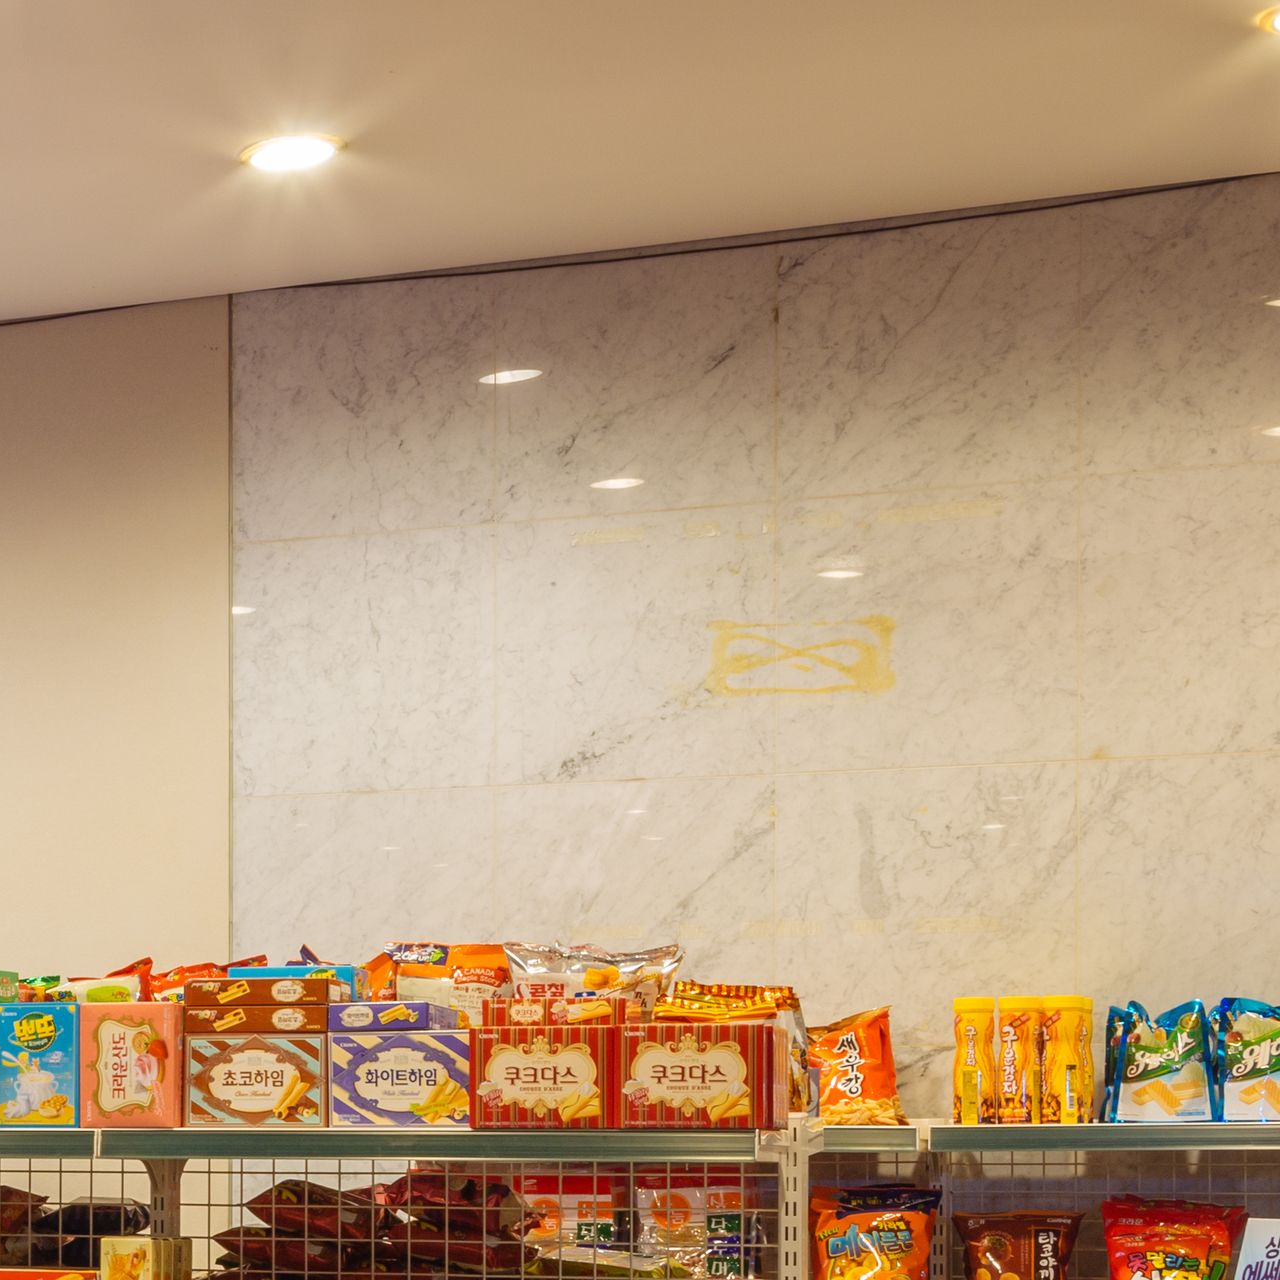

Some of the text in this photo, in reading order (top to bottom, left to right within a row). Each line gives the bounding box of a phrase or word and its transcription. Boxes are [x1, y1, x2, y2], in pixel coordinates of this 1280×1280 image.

[464, 968, 495, 977] CANADA
[836, 1034, 864, 1097] 새우깡
[1001, 1026, 1018, 1094] 구운감자
[221, 1069, 285, 1088] 쵸코하임
[364, 1068, 438, 1088] 화이트하임
[504, 1063, 579, 1086] 쿠크다스
[650, 1063, 728, 1085] 쿠크다스
[828, 1224, 913, 1261] 메이플콘
[1127, 1251, 1201, 1272] 못말리는
